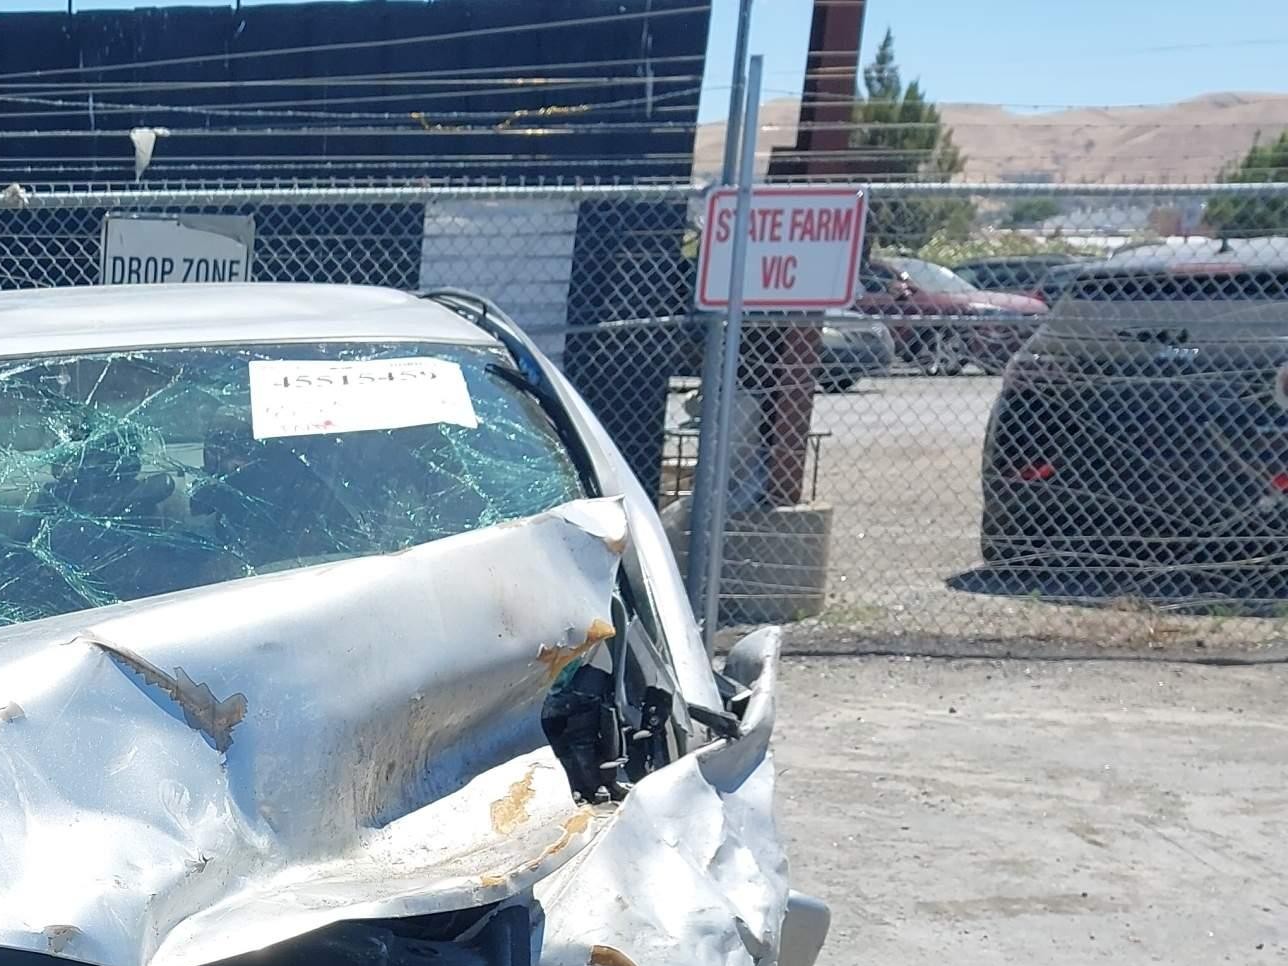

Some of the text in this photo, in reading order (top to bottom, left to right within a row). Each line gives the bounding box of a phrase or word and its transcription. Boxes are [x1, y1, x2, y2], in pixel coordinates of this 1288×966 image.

[715, 207, 854, 243] SATE FARM
[112, 256, 174, 284] DROP
[761, 255, 798, 290] VIC
